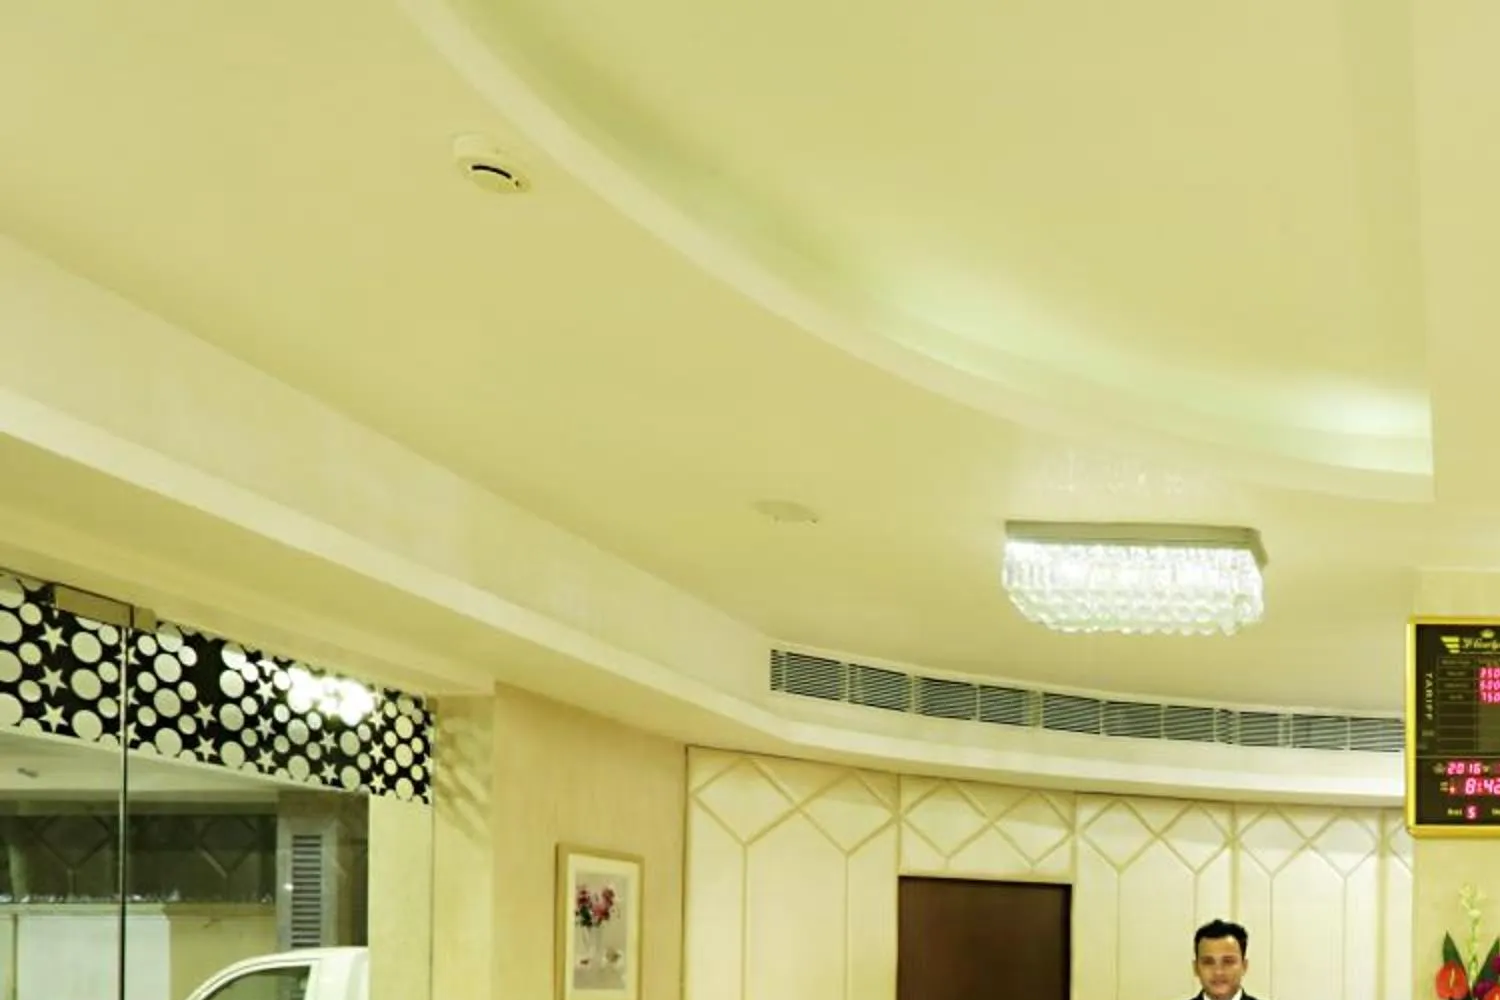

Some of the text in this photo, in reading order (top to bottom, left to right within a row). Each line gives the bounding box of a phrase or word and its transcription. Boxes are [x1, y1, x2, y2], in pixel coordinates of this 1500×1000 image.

[1424, 671, 1434, 721] TARIFF
[1447, 761, 1482, 775] 2016
[1466, 805, 1478, 819] 5
